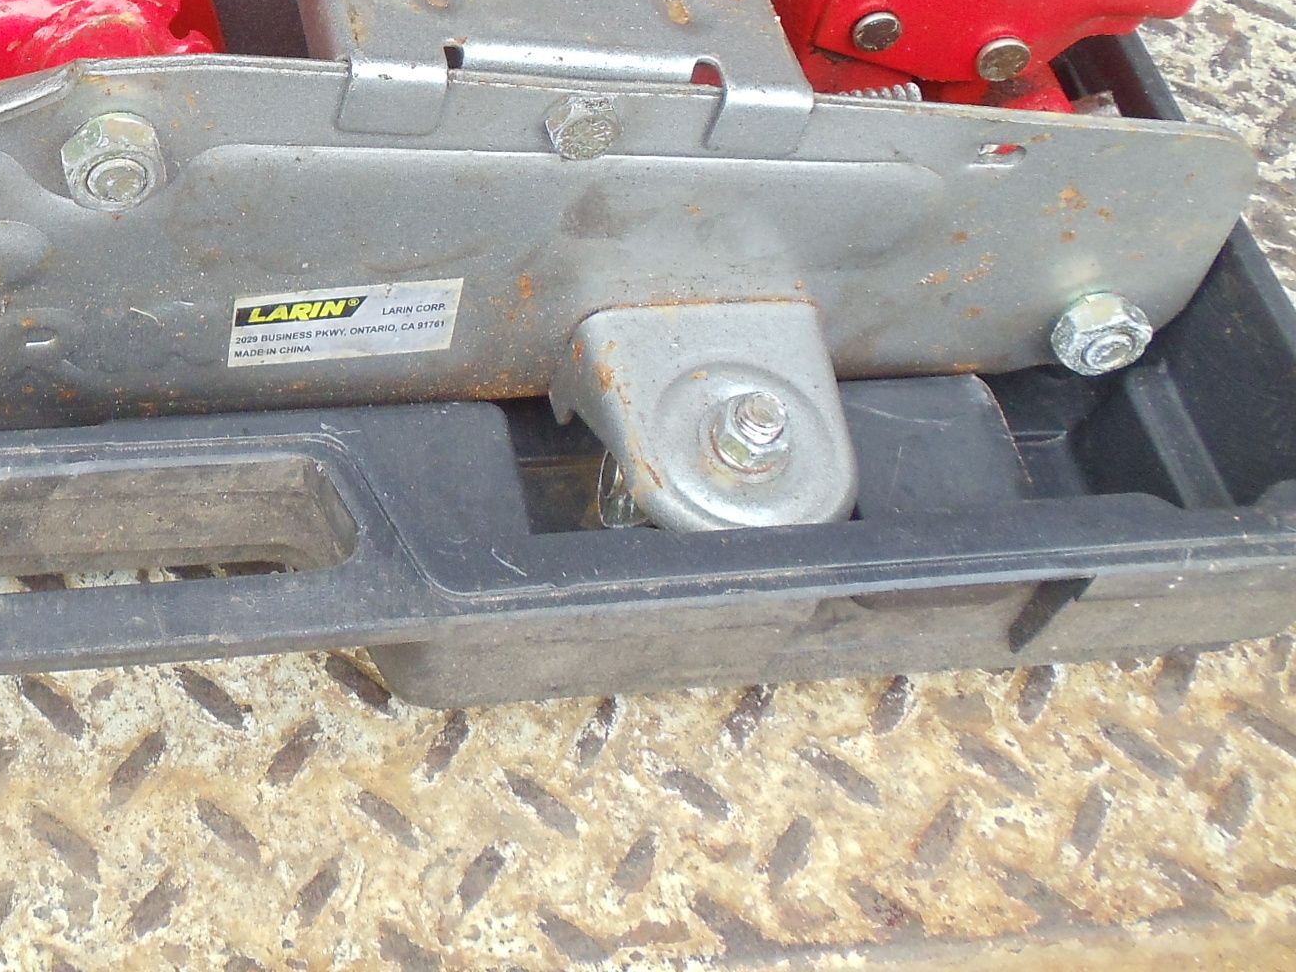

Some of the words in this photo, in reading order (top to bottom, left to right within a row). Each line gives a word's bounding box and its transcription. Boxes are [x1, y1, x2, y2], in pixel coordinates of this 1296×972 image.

[248, 299, 347, 323] LARIN
[381, 305, 414, 316] LARIN
[415, 302, 446, 314] CORP.
[235, 336, 258, 345] 2029
[260, 331, 313, 343] BUSINESS
[315, 328, 347, 339] PKWY,
[349, 323, 398, 336] ONTARIO,
[400, 321, 415, 331] CA
[417, 320, 445, 330] 91761
[234, 348, 264, 358] MADE
[266, 348, 277, 356] IN
[279, 345, 311, 354] CHINA
